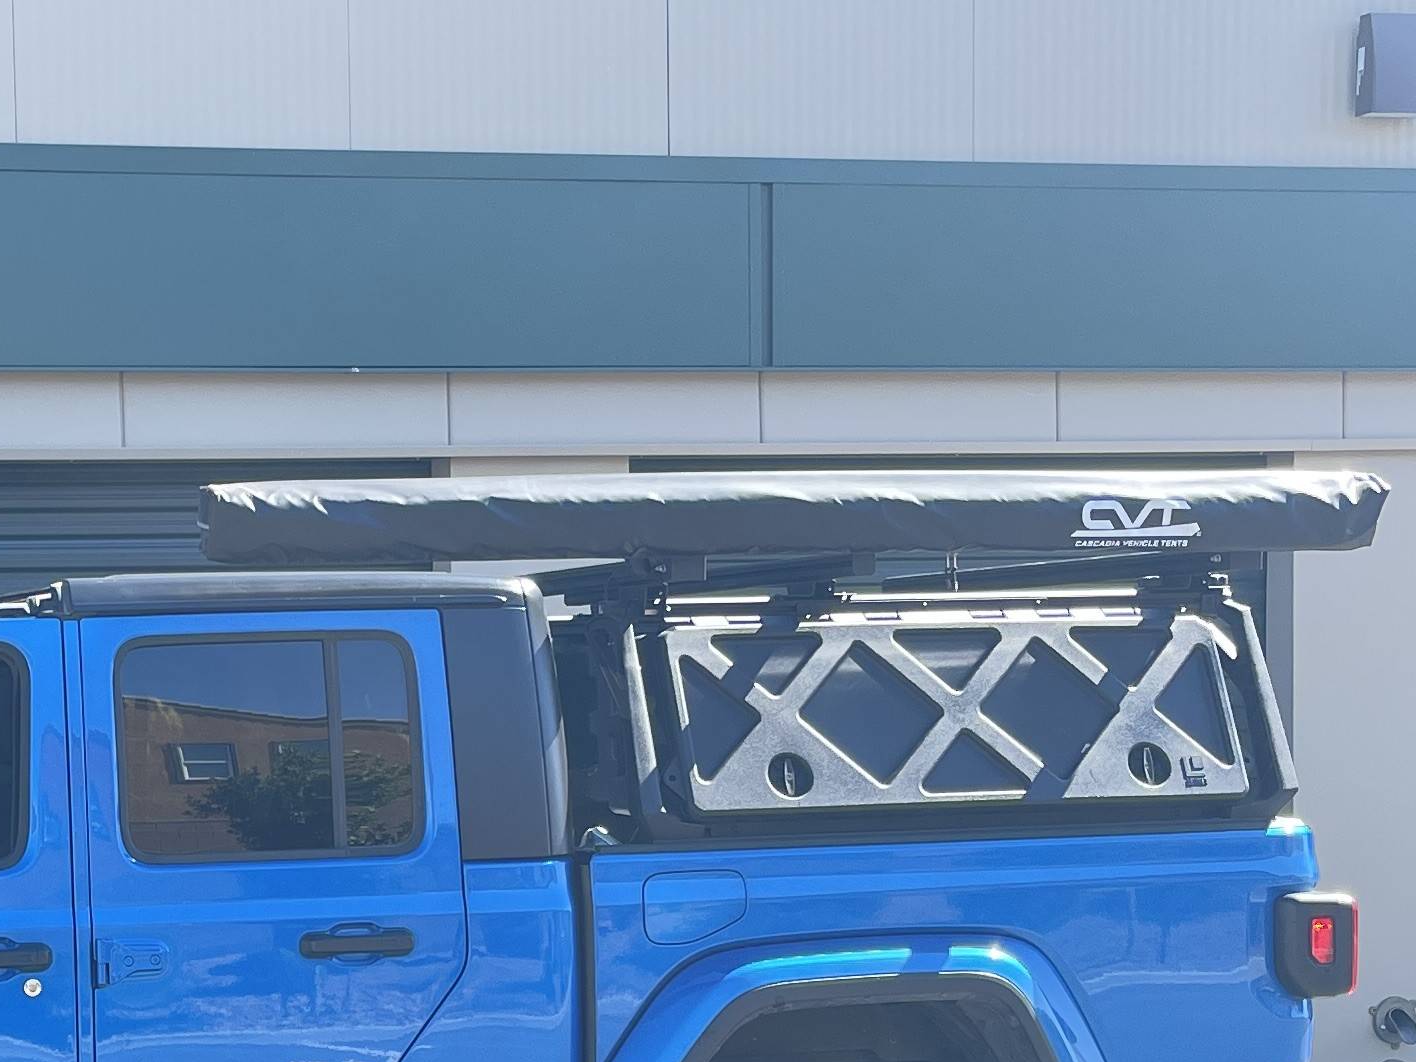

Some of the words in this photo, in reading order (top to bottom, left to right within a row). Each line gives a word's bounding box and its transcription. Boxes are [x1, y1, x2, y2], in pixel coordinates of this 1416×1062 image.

[1082, 500, 1192, 530] CVT
[1074, 539, 1121, 547] CASCADIA
[1122, 539, 1160, 547] VEHICLE
[1161, 539, 1189, 547] TENTS
